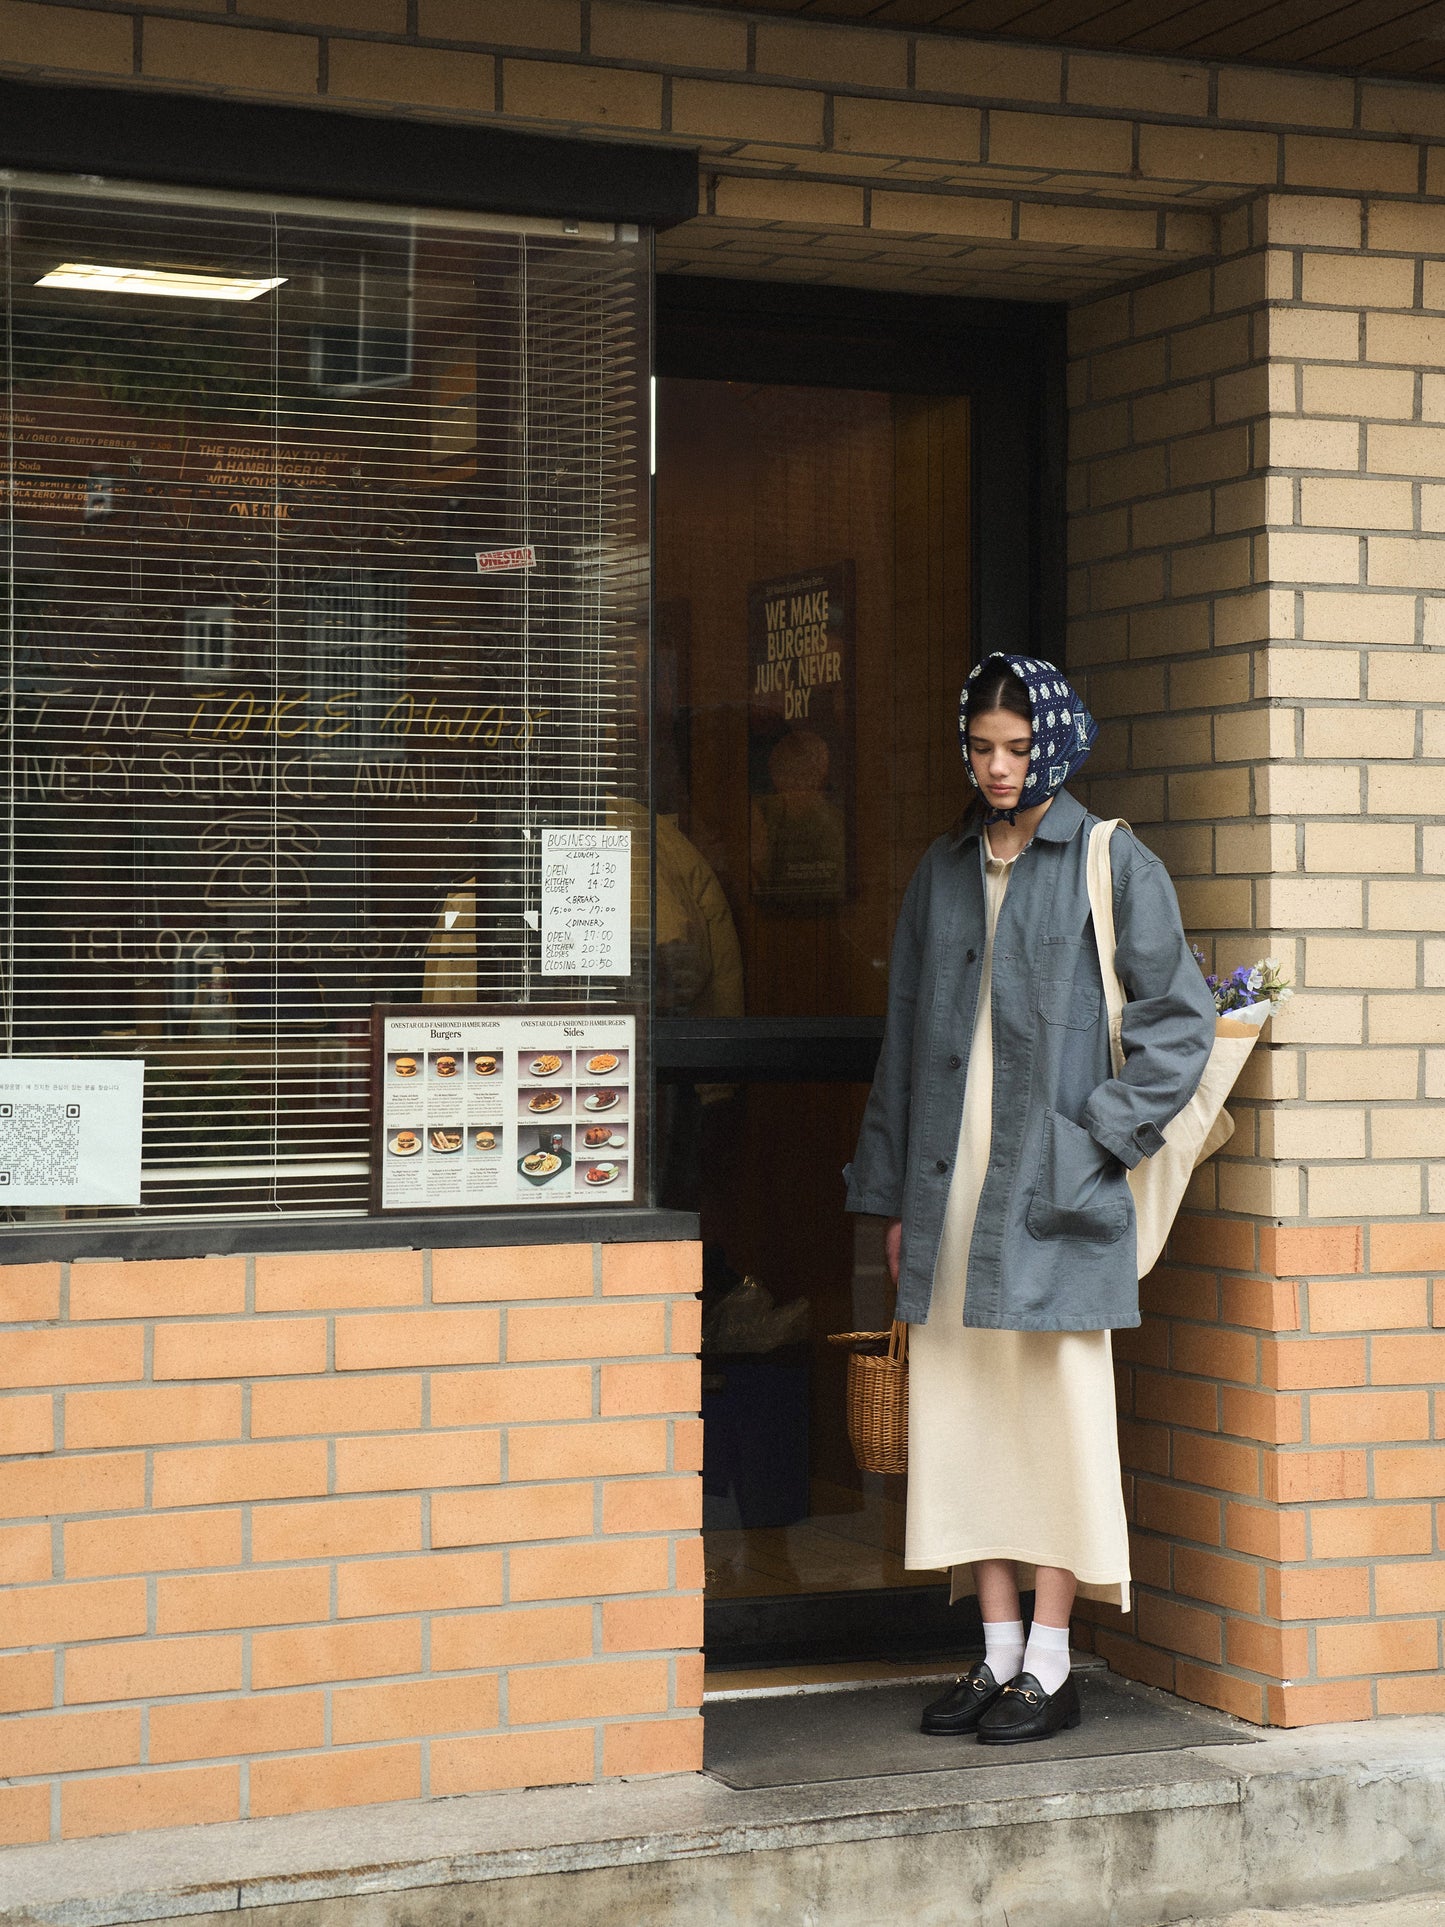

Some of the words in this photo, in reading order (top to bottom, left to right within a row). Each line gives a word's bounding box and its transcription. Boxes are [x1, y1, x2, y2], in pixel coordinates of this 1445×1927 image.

[32, 434, 57, 443] OREO
[65, 436, 96, 446] FRUITY
[97, 439, 137, 449] PEBBLES
[199, 444, 225, 458] THE
[229, 447, 269, 460] RIGHT
[303, 451, 320, 462] TO
[18, 461, 41, 471] Soda
[226, 461, 313, 475] HAMBURGER
[315, 466, 327, 476] IS
[32, 491, 56, 500] ZERO
[479, 548, 532, 567] ONESTAR
[765, 599, 786, 632] WE
[790, 590, 829, 627] MAKE
[767, 622, 828, 662] BURGERS
[754, 660, 795, 695] JUICY,
[798, 652, 842, 688] NEVER
[784, 687, 812, 720] DRY
[82, 686, 155, 736] IN
[187, 689, 358, 741] TAKE
[380, 692, 550, 750] AWAY
[160, 751, 331, 800] SERVCE
[548, 834, 597, 847] BUSINESS
[602, 834, 629, 849] HOURS
[546, 864, 568, 877] OPEN
[590, 862, 617, 876] 11:30
[545, 878, 576, 887] KITCHEN
[588, 878, 616, 890] 14:20
[545, 886, 569, 894] CLOSES
[549, 907, 572, 915] 15:00
[589, 906, 616, 915] 17:00
[546, 931, 571, 942] OPEN
[583, 930, 614, 941] 17:00
[546, 943, 575, 952] KITCHEN
[581, 943, 612, 954] 20:20
[546, 951, 569, 959] CLOSES
[545, 960, 576, 971] CLOSING
[581, 958, 613, 969] 20:50
[430, 1029, 462, 1040] Burgers
[563, 1027, 585, 1037] Sides
